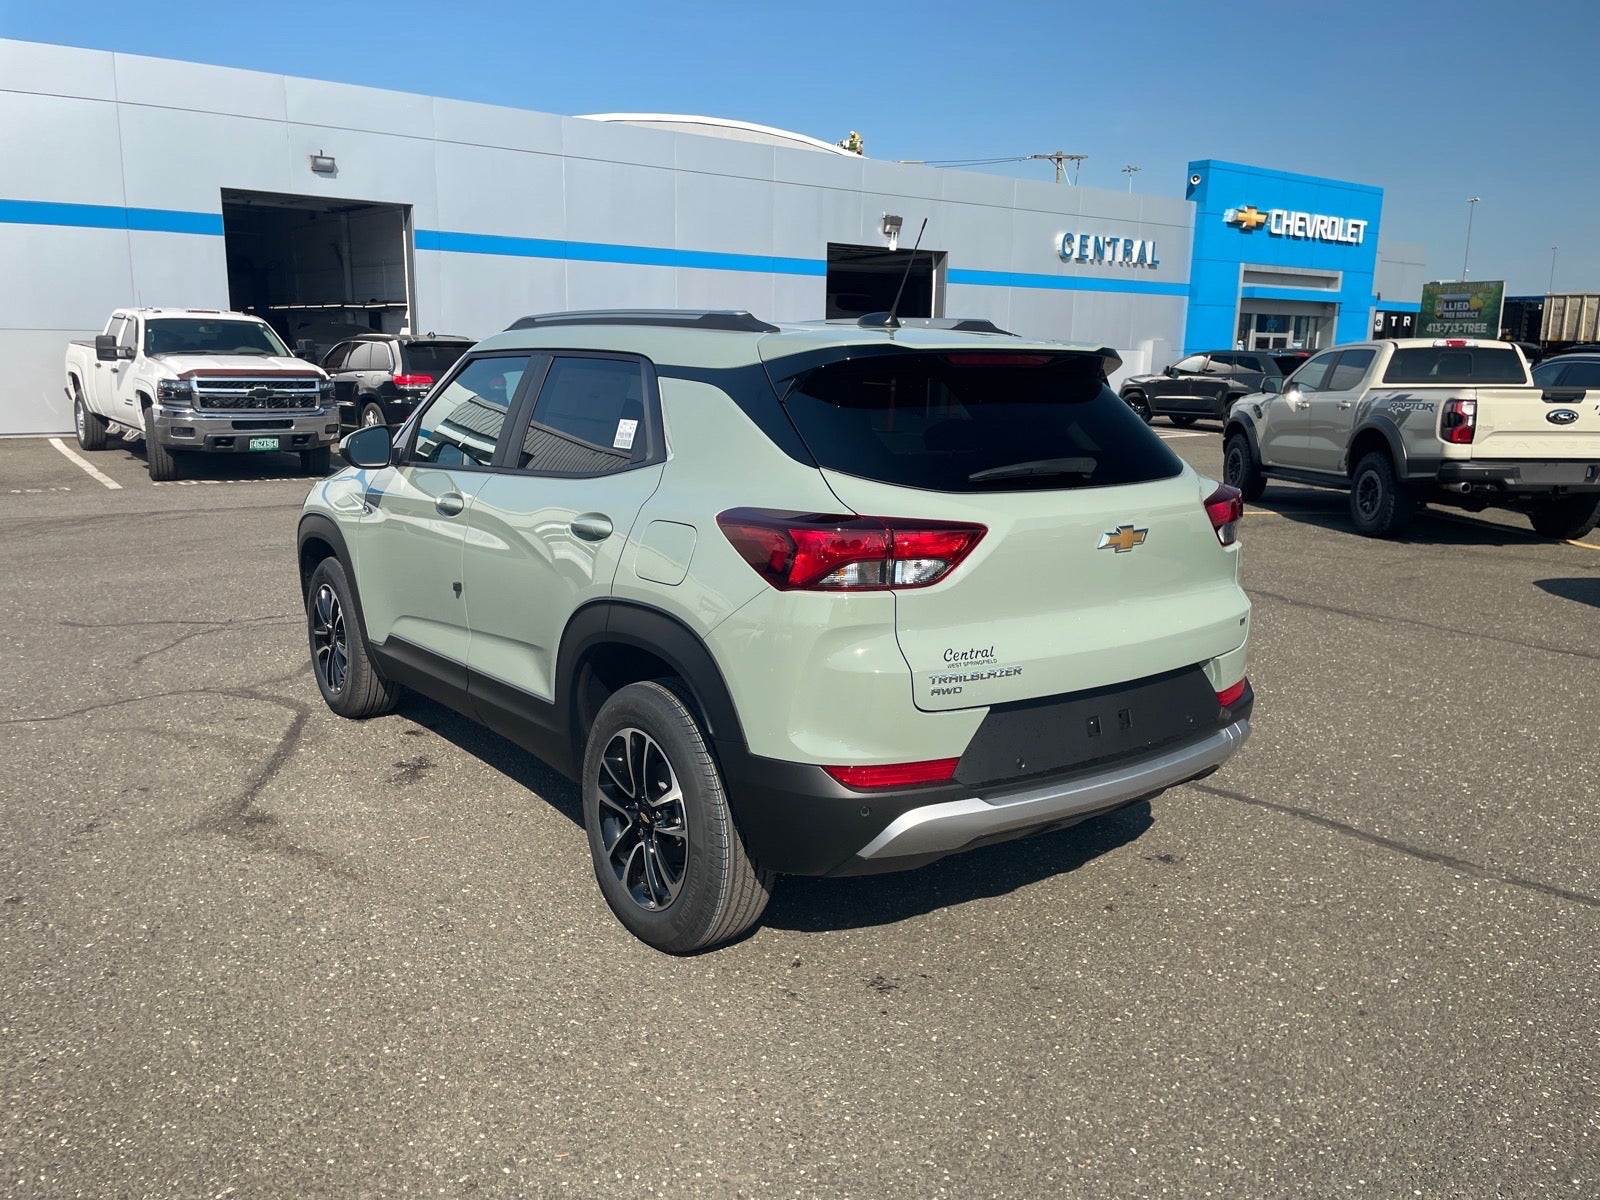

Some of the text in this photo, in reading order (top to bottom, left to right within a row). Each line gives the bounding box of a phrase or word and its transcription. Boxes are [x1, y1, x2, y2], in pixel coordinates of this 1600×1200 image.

[1269, 209, 1368, 244] CHEVROLET
[1059, 232, 1160, 265] CENTRAL
[1390, 402, 1435, 414] RAPTOR
[943, 646, 995, 662] Central
[963, 659, 998, 667] SPRINGFIELD
[928, 665, 1023, 685] TRAILBLAZER
[930, 686, 963, 696] AWD
